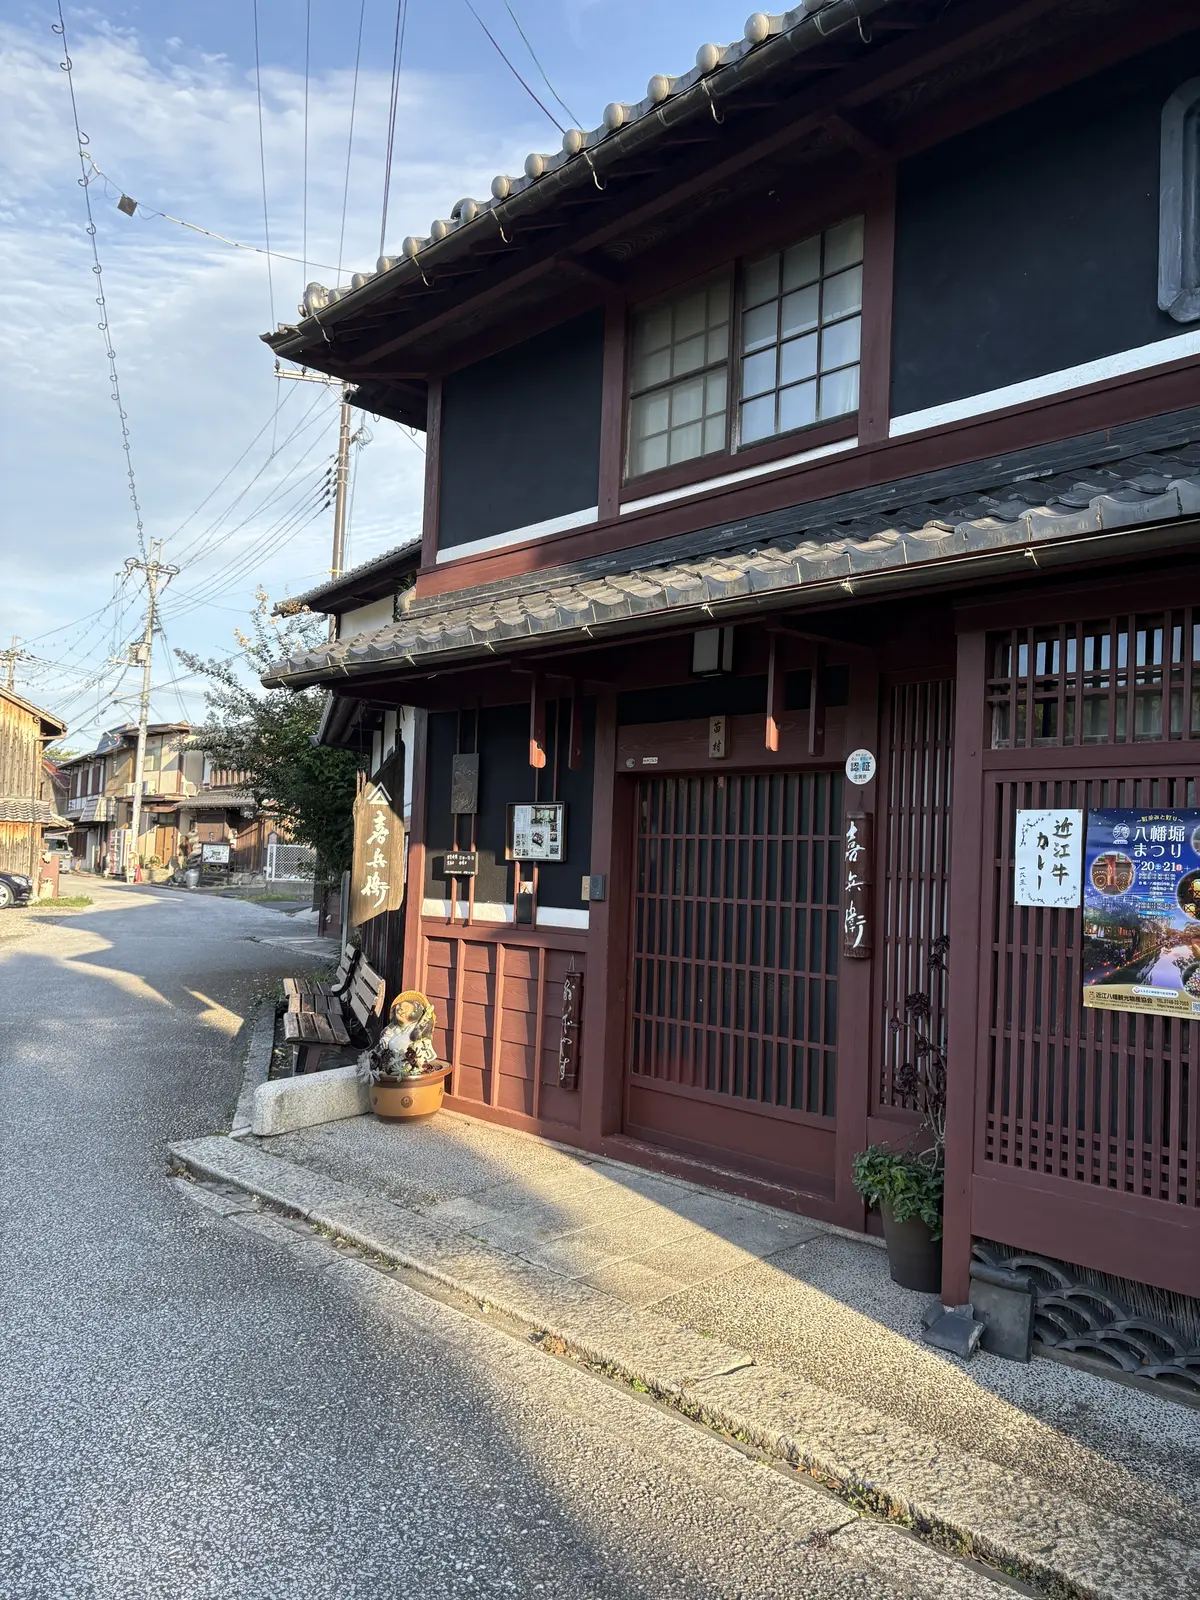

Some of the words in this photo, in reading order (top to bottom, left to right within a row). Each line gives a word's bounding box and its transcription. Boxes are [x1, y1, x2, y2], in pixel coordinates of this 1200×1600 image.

[851, 762, 871, 772] 認証
[1132, 825, 1185, 842] 八幡堀
[1051, 817, 1073, 886] 近江牛
[1133, 843, 1182, 858] まつり
